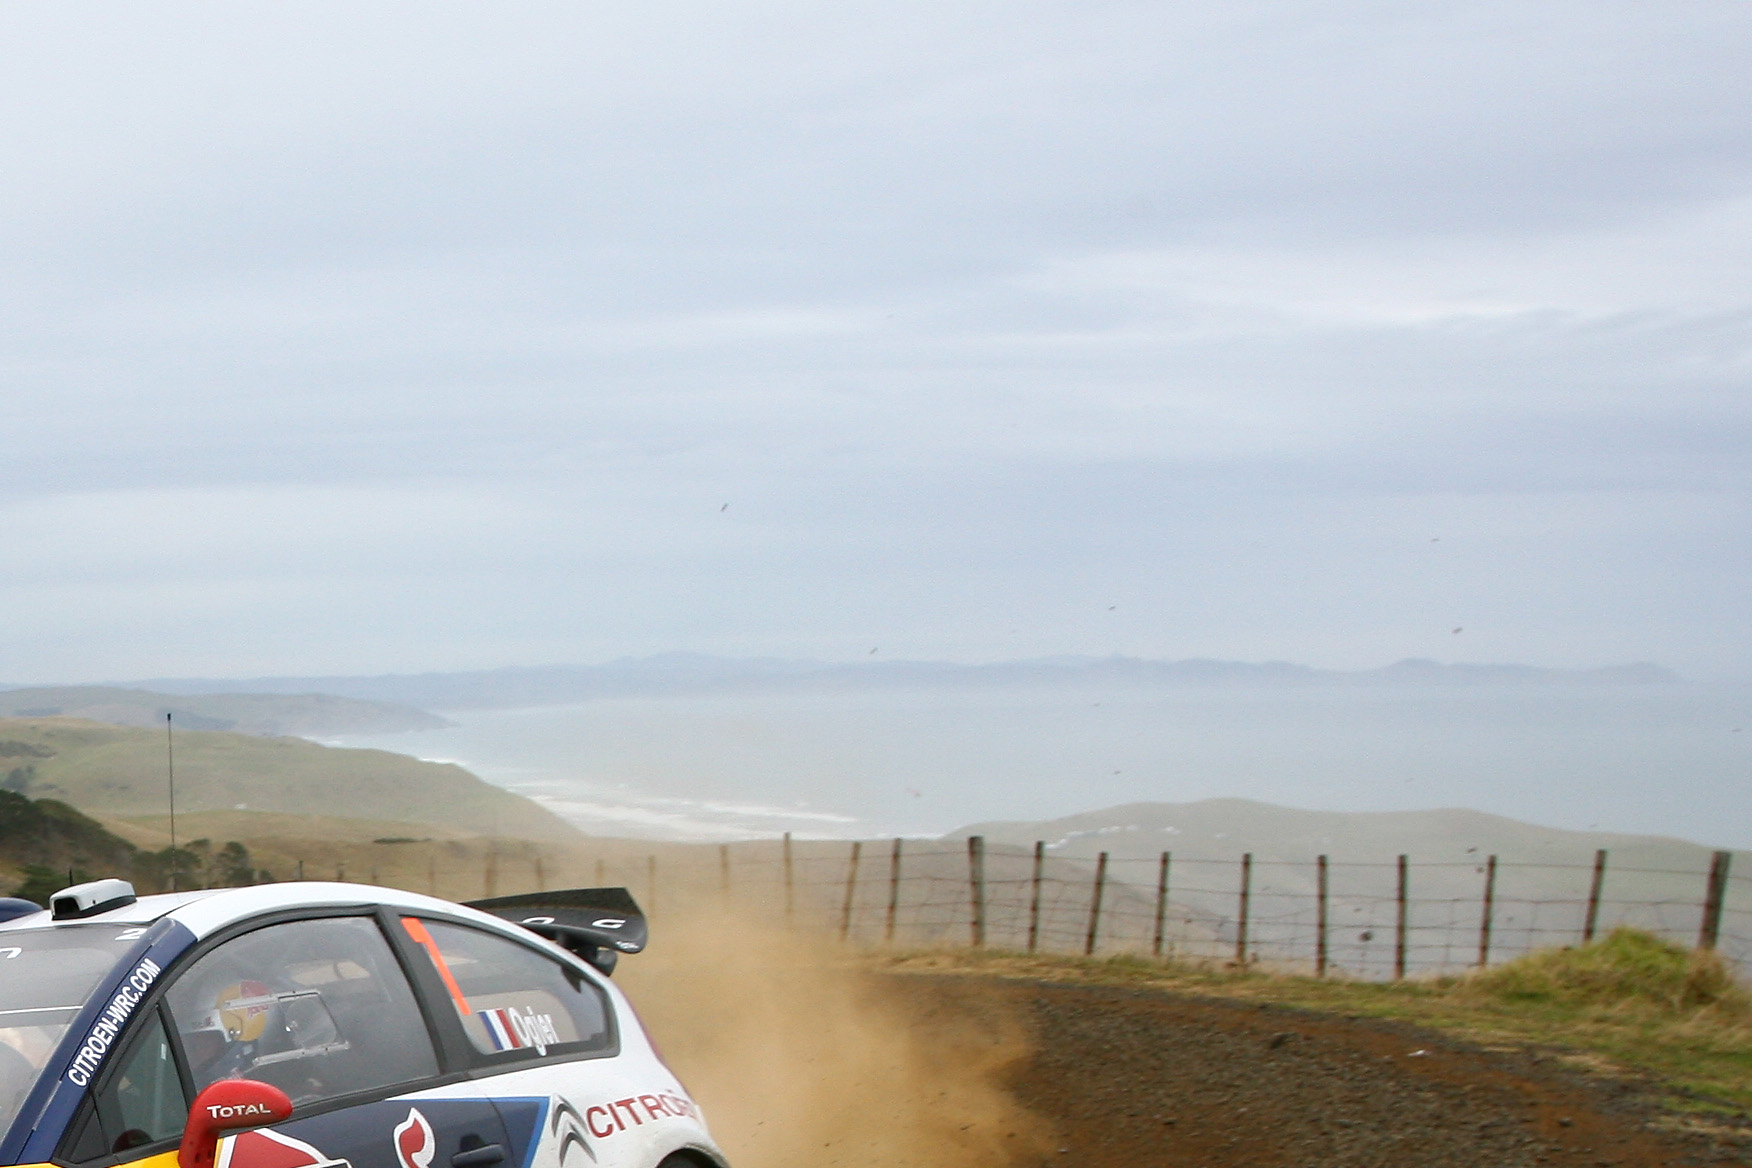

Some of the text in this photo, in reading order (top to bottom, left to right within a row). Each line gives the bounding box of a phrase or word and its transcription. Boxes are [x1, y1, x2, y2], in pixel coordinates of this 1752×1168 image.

[68, 957, 161, 1087] CITROEN-WRC.COM
[507, 1005, 560, 1057] Ogier
[207, 1103, 271, 1119] TOTAL
